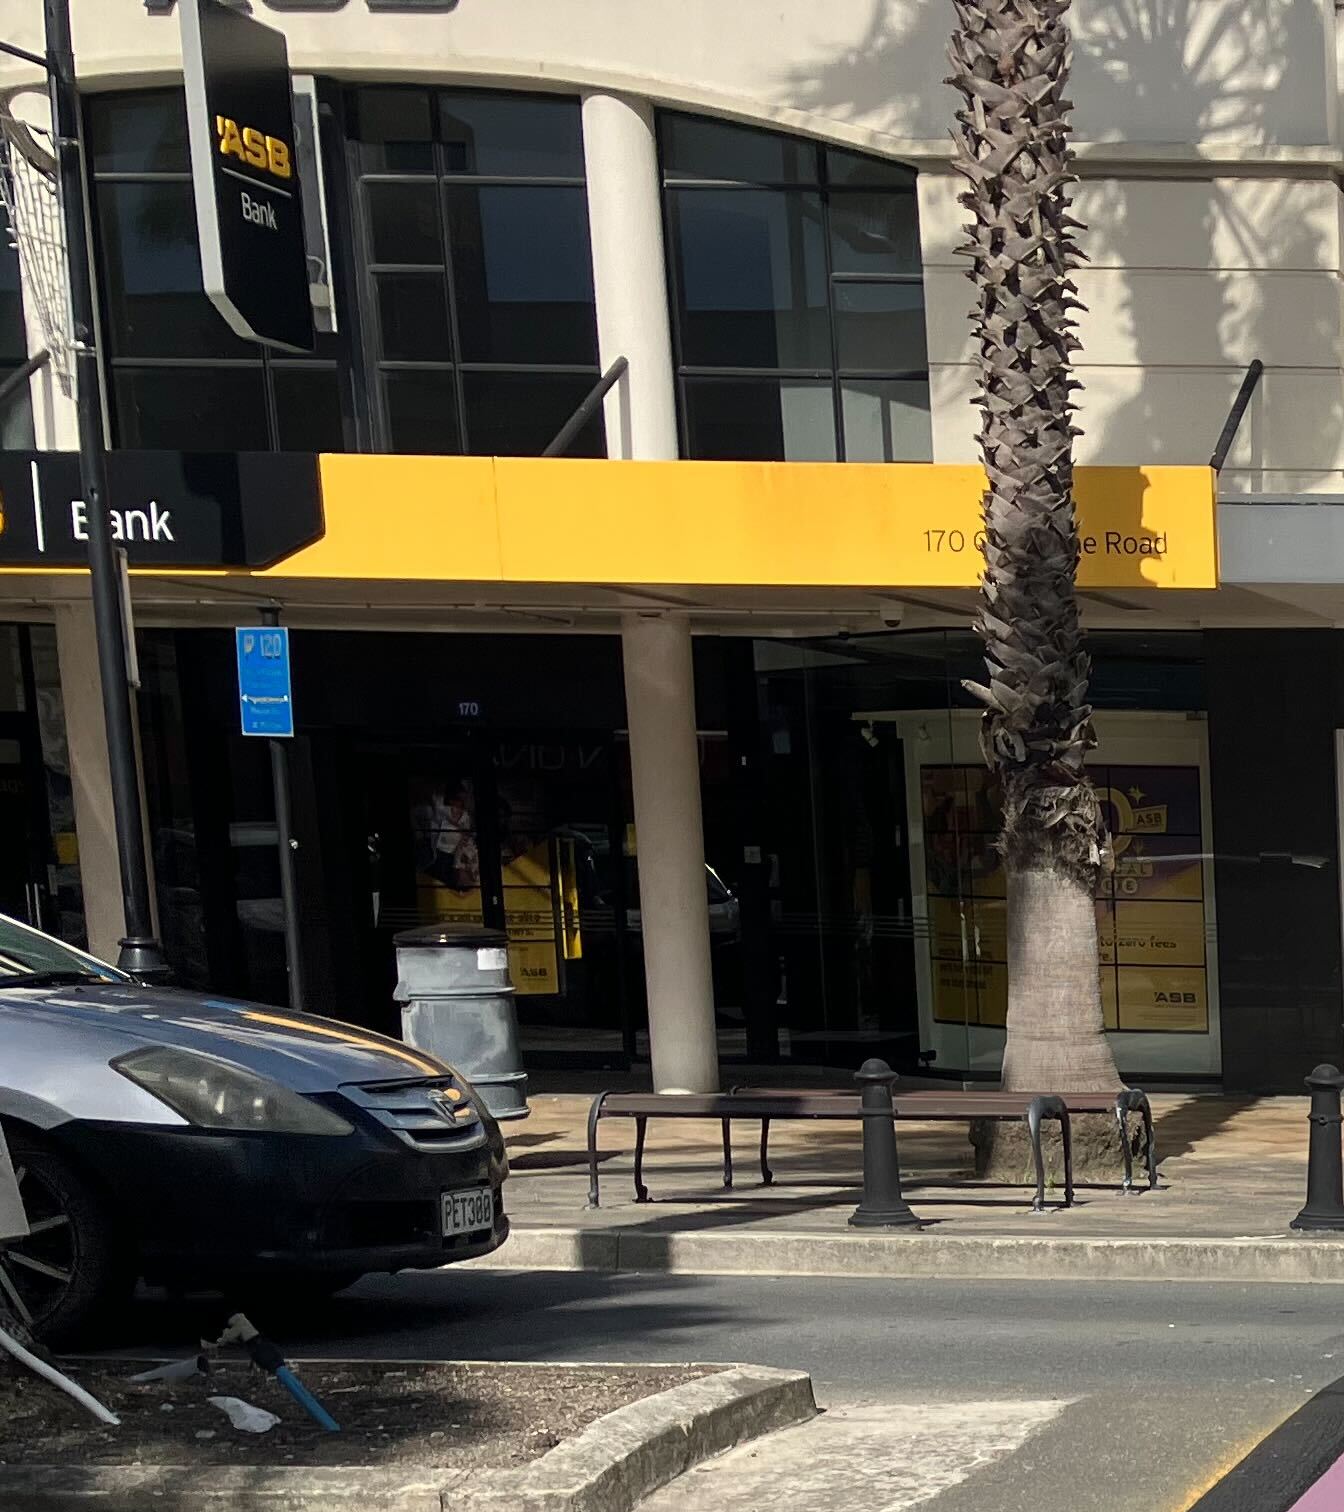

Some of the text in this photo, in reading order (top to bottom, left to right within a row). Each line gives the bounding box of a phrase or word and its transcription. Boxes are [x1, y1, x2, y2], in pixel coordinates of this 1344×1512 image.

[216, 115, 291, 178] ASB
[240, 191, 278, 231] Bank
[71, 500, 174, 542] Bank
[923, 530, 965, 552] 170
[1106, 531, 1168, 555] Road
[459, 702, 479, 715] 170
[1153, 991, 1197, 1003] ASB
